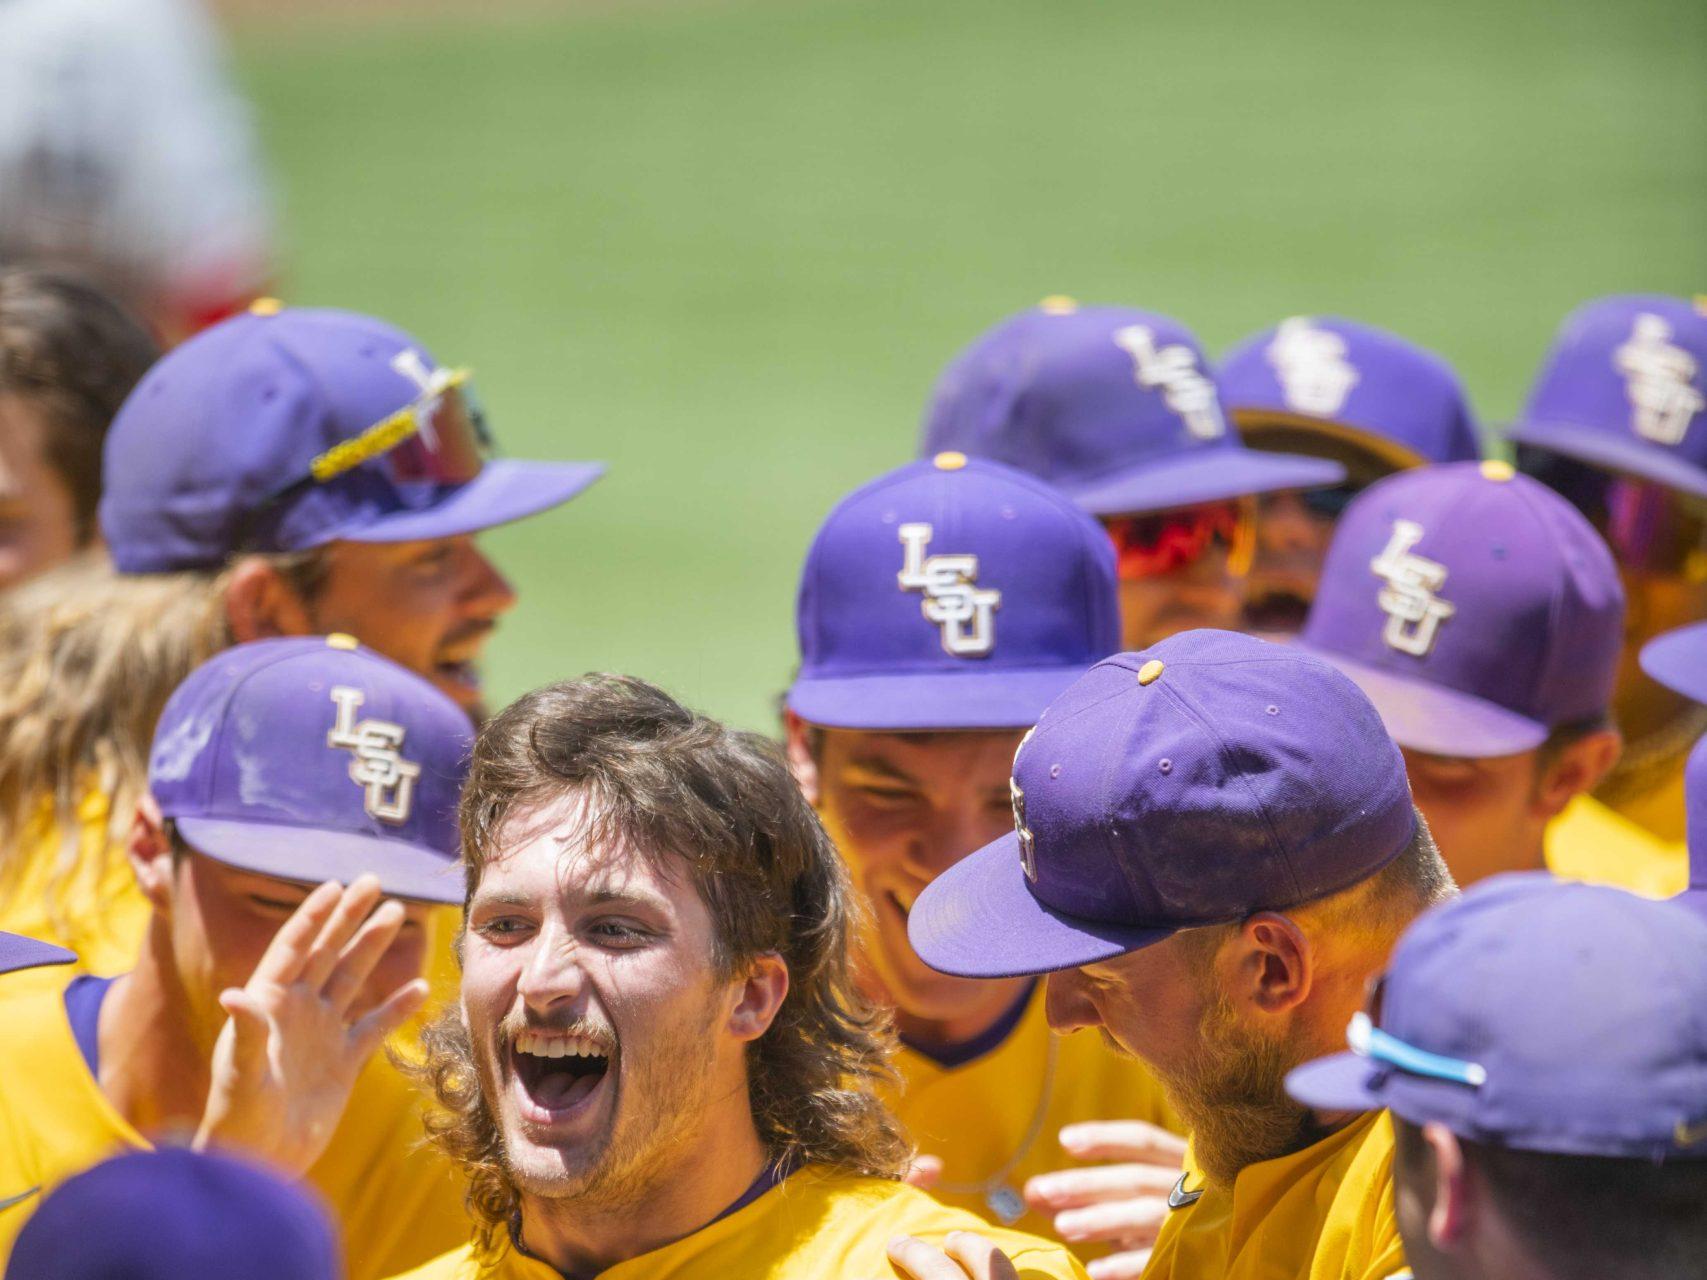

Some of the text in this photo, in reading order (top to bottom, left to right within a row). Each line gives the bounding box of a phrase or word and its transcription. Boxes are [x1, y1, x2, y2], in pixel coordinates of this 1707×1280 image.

[897, 521, 1001, 657] LSU
[1370, 519, 1456, 657] LSU
[326, 684, 422, 826] LSU
